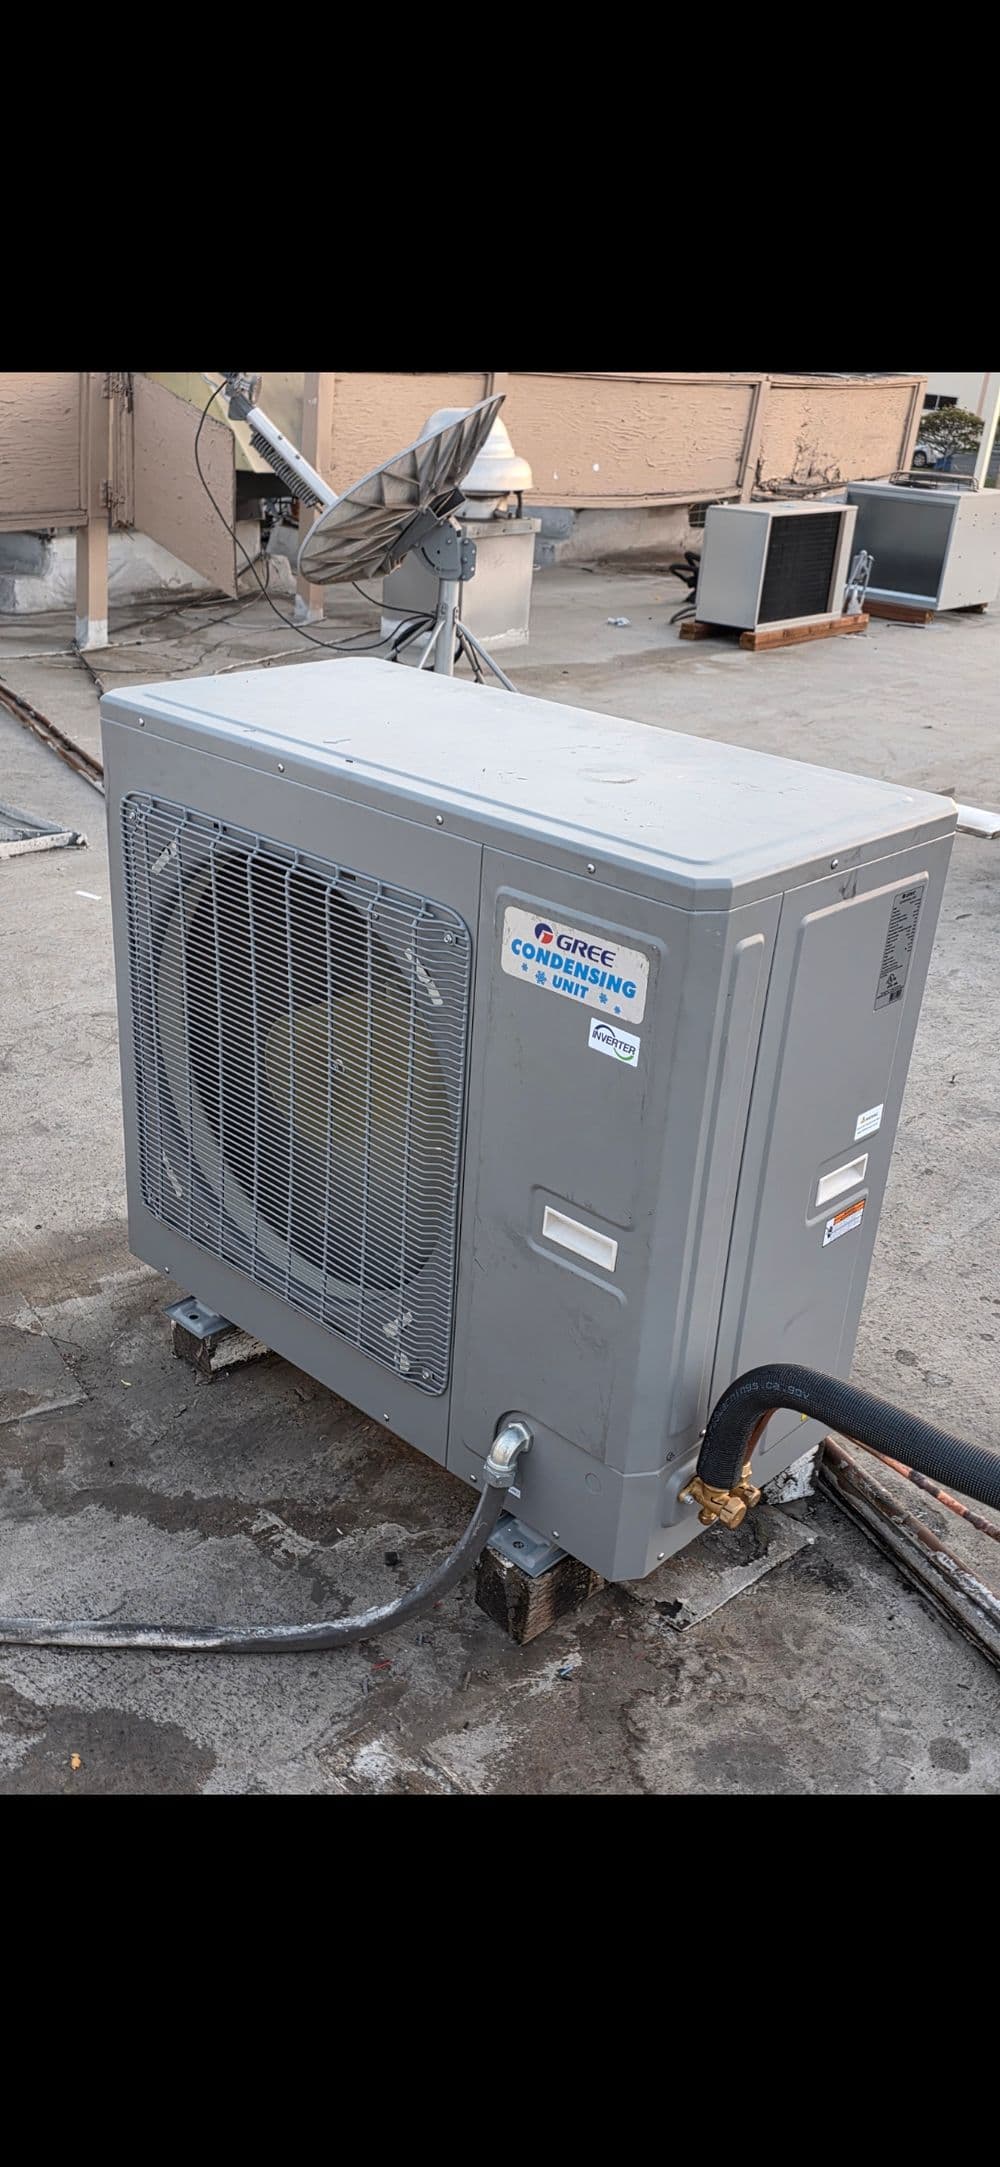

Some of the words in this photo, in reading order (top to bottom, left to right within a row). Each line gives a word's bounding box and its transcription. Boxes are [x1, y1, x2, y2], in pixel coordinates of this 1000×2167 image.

[557, 934, 617, 968] GREE
[511, 939, 638, 999] CONDENSING
[552, 975, 589, 999] UNIT
[592, 1030, 636, 1056] INVERTER
